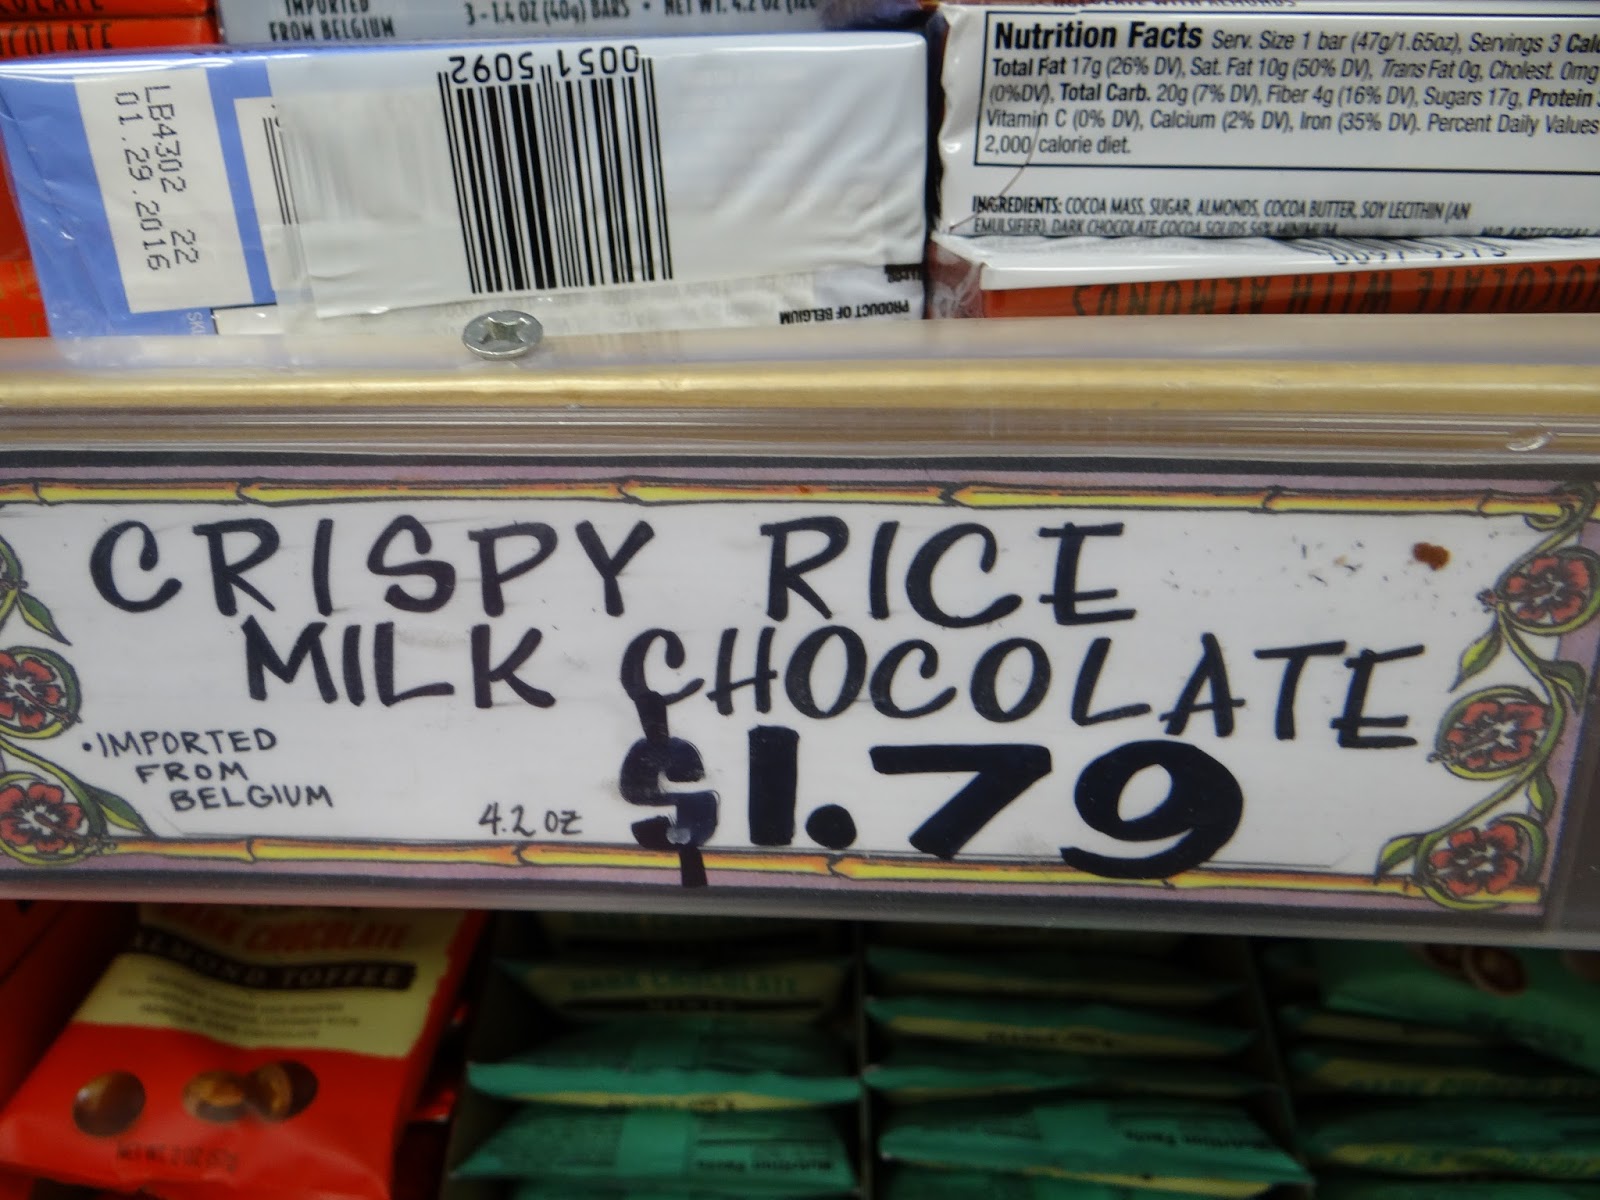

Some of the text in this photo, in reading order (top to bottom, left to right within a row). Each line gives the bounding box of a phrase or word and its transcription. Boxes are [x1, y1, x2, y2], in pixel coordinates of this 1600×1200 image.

[269, 16, 396, 41] FROM BELGIUM
[994, 21, 1116, 50] Nutrition
[1128, 21, 1202, 49] Facts
[1212, 29, 1252, 50] Serv.
[1259, 30, 1295, 51] Size
[1303, 32, 1310, 51] 1
[1317, 31, 1347, 51] bar
[1468, 32, 1543, 56] Servings
[1548, 33, 1561, 53] 3
[449, 45, 640, 84] 0051 5092
[992, 58, 1033, 77] Total
[1038, 57, 1066, 75] Fat
[1071, 57, 1101, 78] 17g
[1106, 56, 1149, 78] (26%
[1153, 57, 1186, 79] DV),
[1190, 57, 1221, 77] Sat.
[1225, 58, 1253, 77] Fat
[1258, 58, 1288, 80] 10g
[1292, 58, 1336, 80] (50%
[1340, 59, 1372, 80] DV),
[1381, 59, 1426, 78] Trans
[1427, 59, 1455, 79] Fat
[1489, 59, 1554, 80] Cholest.
[1560, 61, 1600, 84] 0mg
[1060, 83, 1101, 101] Total
[1106, 83, 1150, 101] Carb.
[1156, 84, 1188, 106] 20g
[1192, 84, 1226, 106] (7%
[1229, 85, 1262, 106] DV),
[1266, 85, 1310, 105] Fiber
[1312, 86, 1334, 107] 4g
[1338, 86, 1383, 107] (16%
[1386, 86, 1419, 107] DV),
[1424, 86, 1482, 109] Sugars
[1528, 88, 1593, 108] Protein
[986, 109, 1049, 128] Vitamin
[1055, 109, 1066, 127] C
[1072, 109, 1106, 131] (0%
[1112, 109, 1144, 131] DV),
[1150, 110, 1216, 129] Calcium
[1221, 110, 1256, 132] (2%
[1260, 111, 1293, 133] DV),
[1300, 111, 1332, 131] Iron
[1338, 112, 1383, 134] (35%
[1427, 112, 1492, 133] Percent
[1496, 112, 1540, 137] Daily
[1545, 114, 1600, 134] Values
[985, 135, 1131, 155] 2,000 calorie diet.
[145, 85, 200, 264] LB4302 22
[972, 195, 1062, 214] INGREDIENTS:
[1065, 196, 1107, 214] COCOA
[1263, 199, 1306, 218] COCOA
[1360, 201, 1385, 219] SOY
[1389, 202, 1443, 220] LECITHIN
[779, 299, 909, 324] PRODUCT OF BELGIUM
[88, 514, 1136, 629] CRISPY RICE
[241, 614, 1425, 749] MILK CHOCOLATE
[135, 761, 249, 783] FROM
[170, 785, 334, 811] BELGIUM
[619, 700, 1244, 887] $1.79
[478, 802, 537, 837] 4.2
